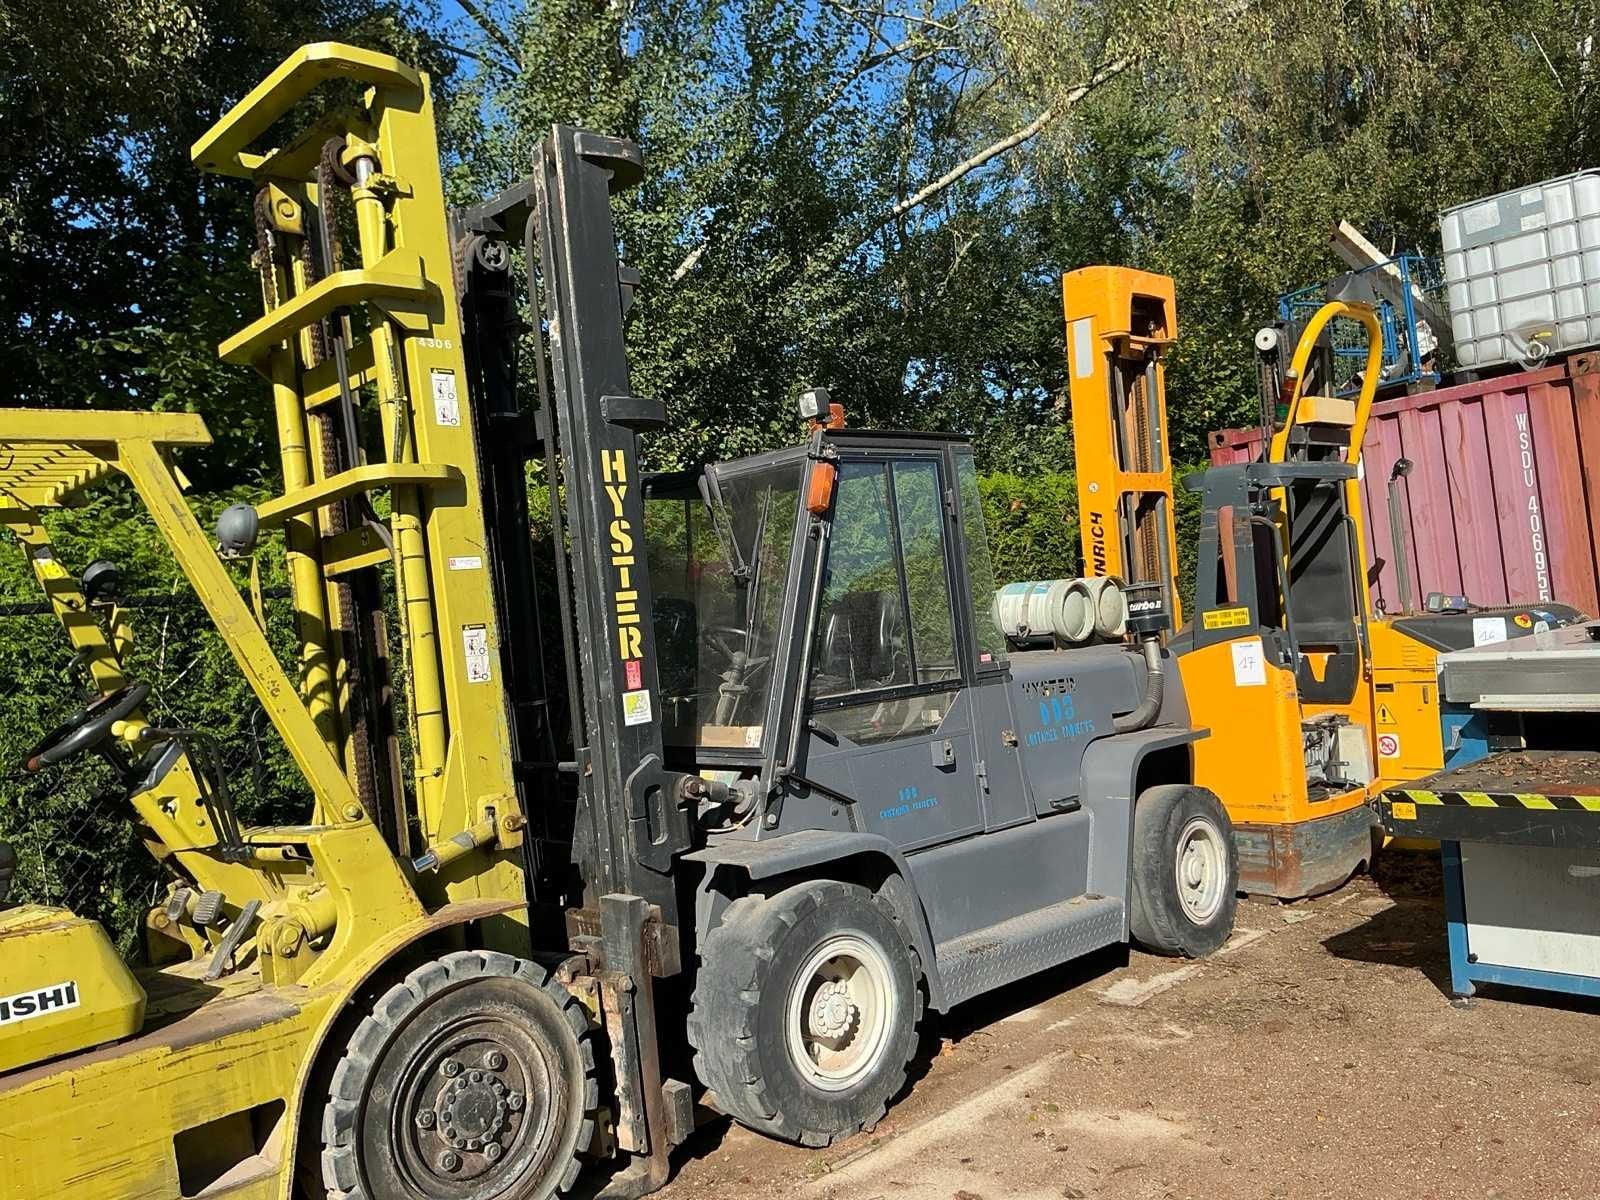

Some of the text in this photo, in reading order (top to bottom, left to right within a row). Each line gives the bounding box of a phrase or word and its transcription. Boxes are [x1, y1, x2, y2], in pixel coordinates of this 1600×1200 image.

[1515, 413, 1535, 488] WSDU
[601, 449, 644, 660] HYSTER
[1129, 600, 1155, 612] turbo
[0, 985, 77, 1021] ISHI
